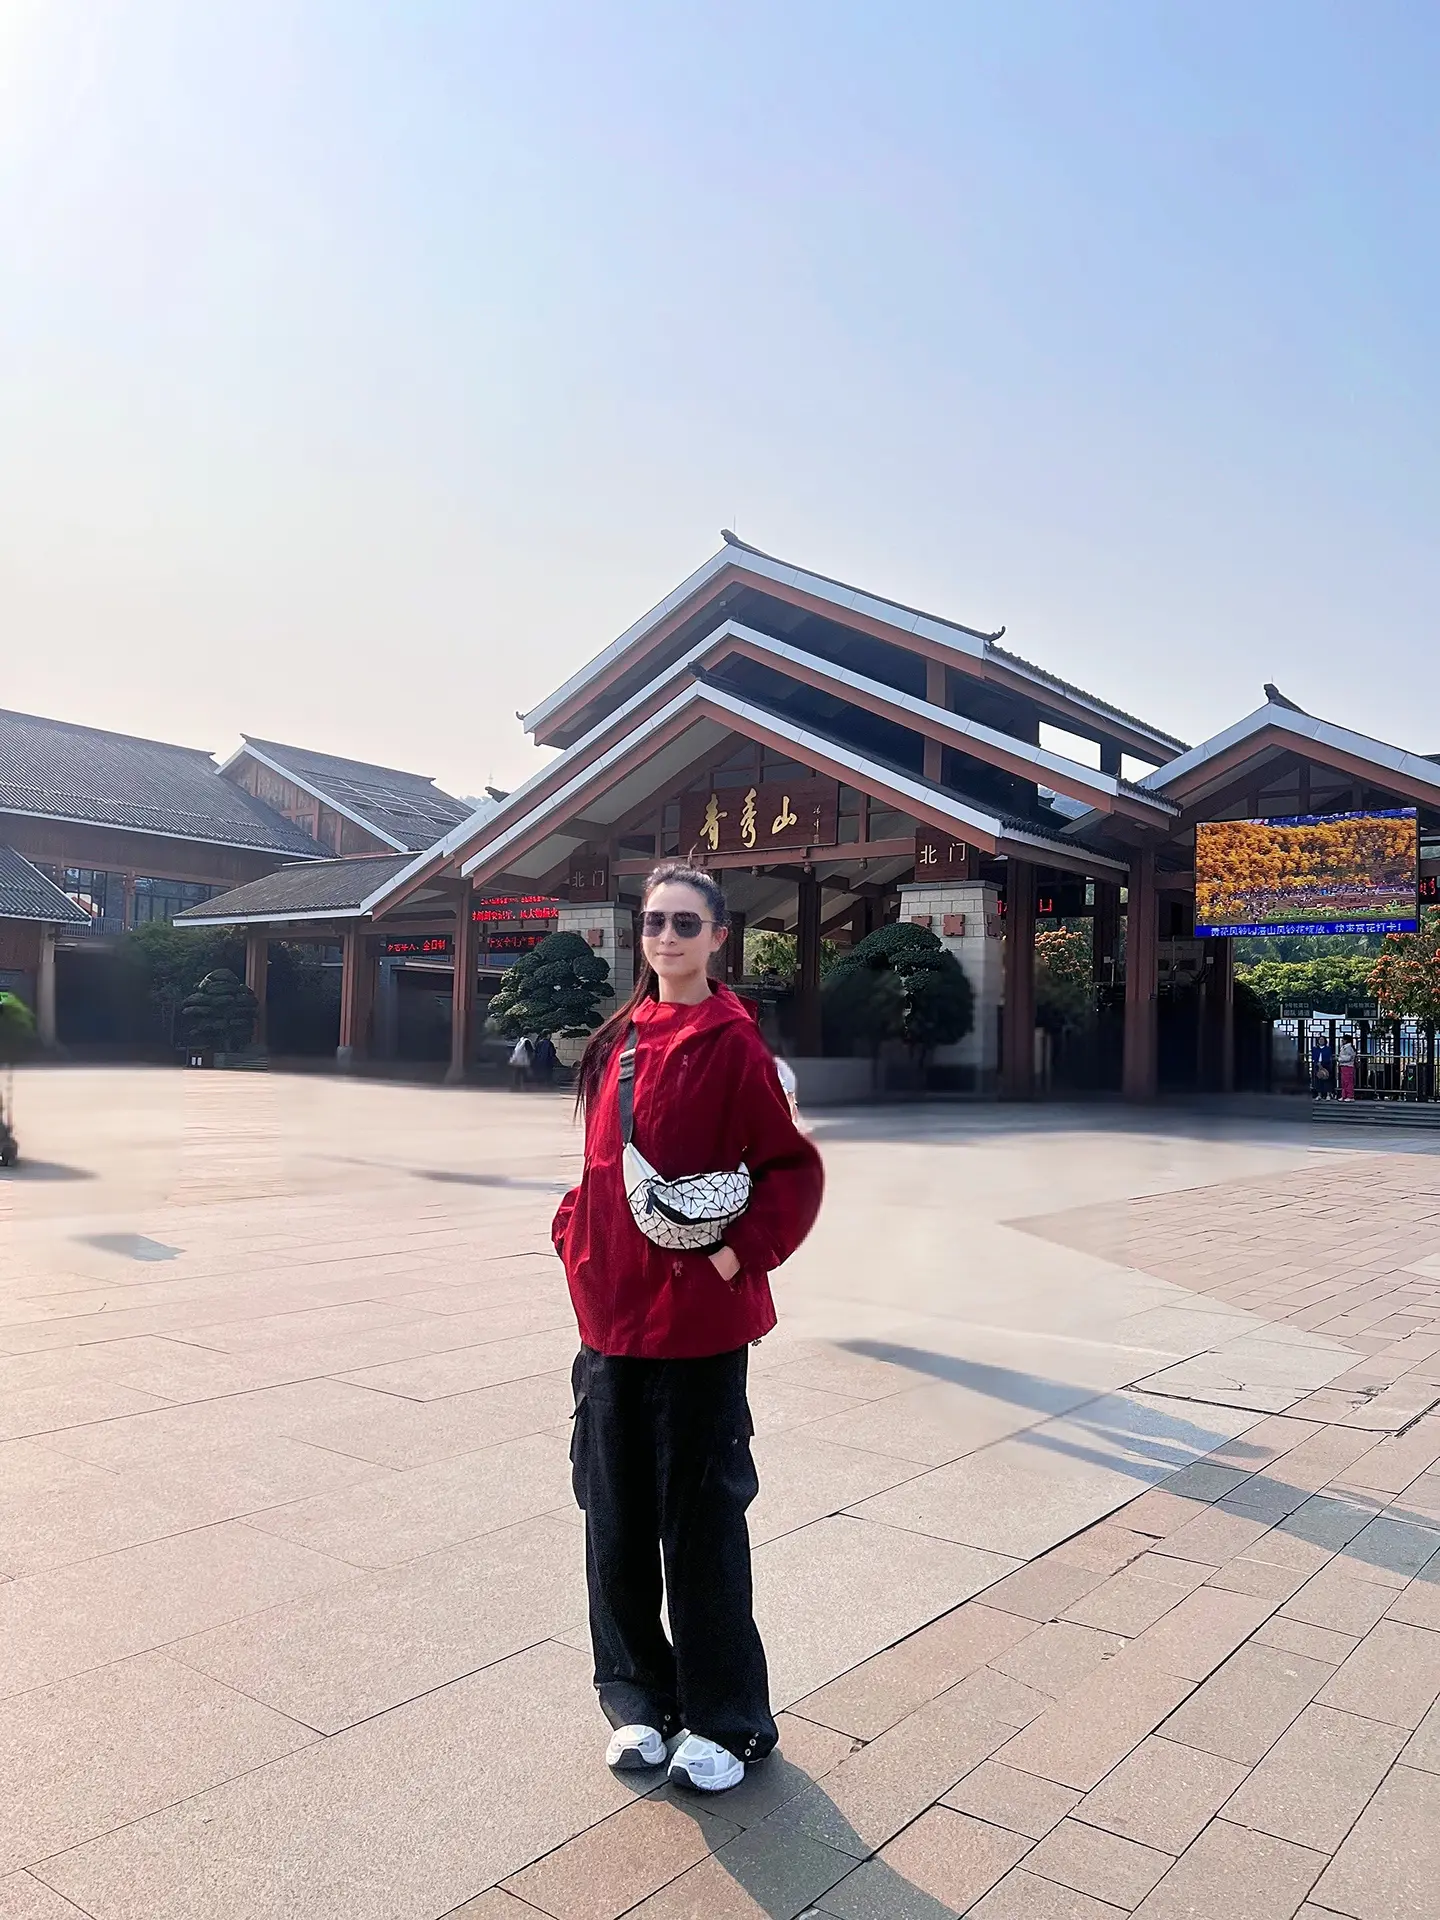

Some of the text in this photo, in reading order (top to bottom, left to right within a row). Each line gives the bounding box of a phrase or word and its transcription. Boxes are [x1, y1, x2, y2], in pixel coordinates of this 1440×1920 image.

[700, 788, 797, 850] 青秀山
[920, 843, 965, 864] 北门
[572, 870, 604, 887] 北门
